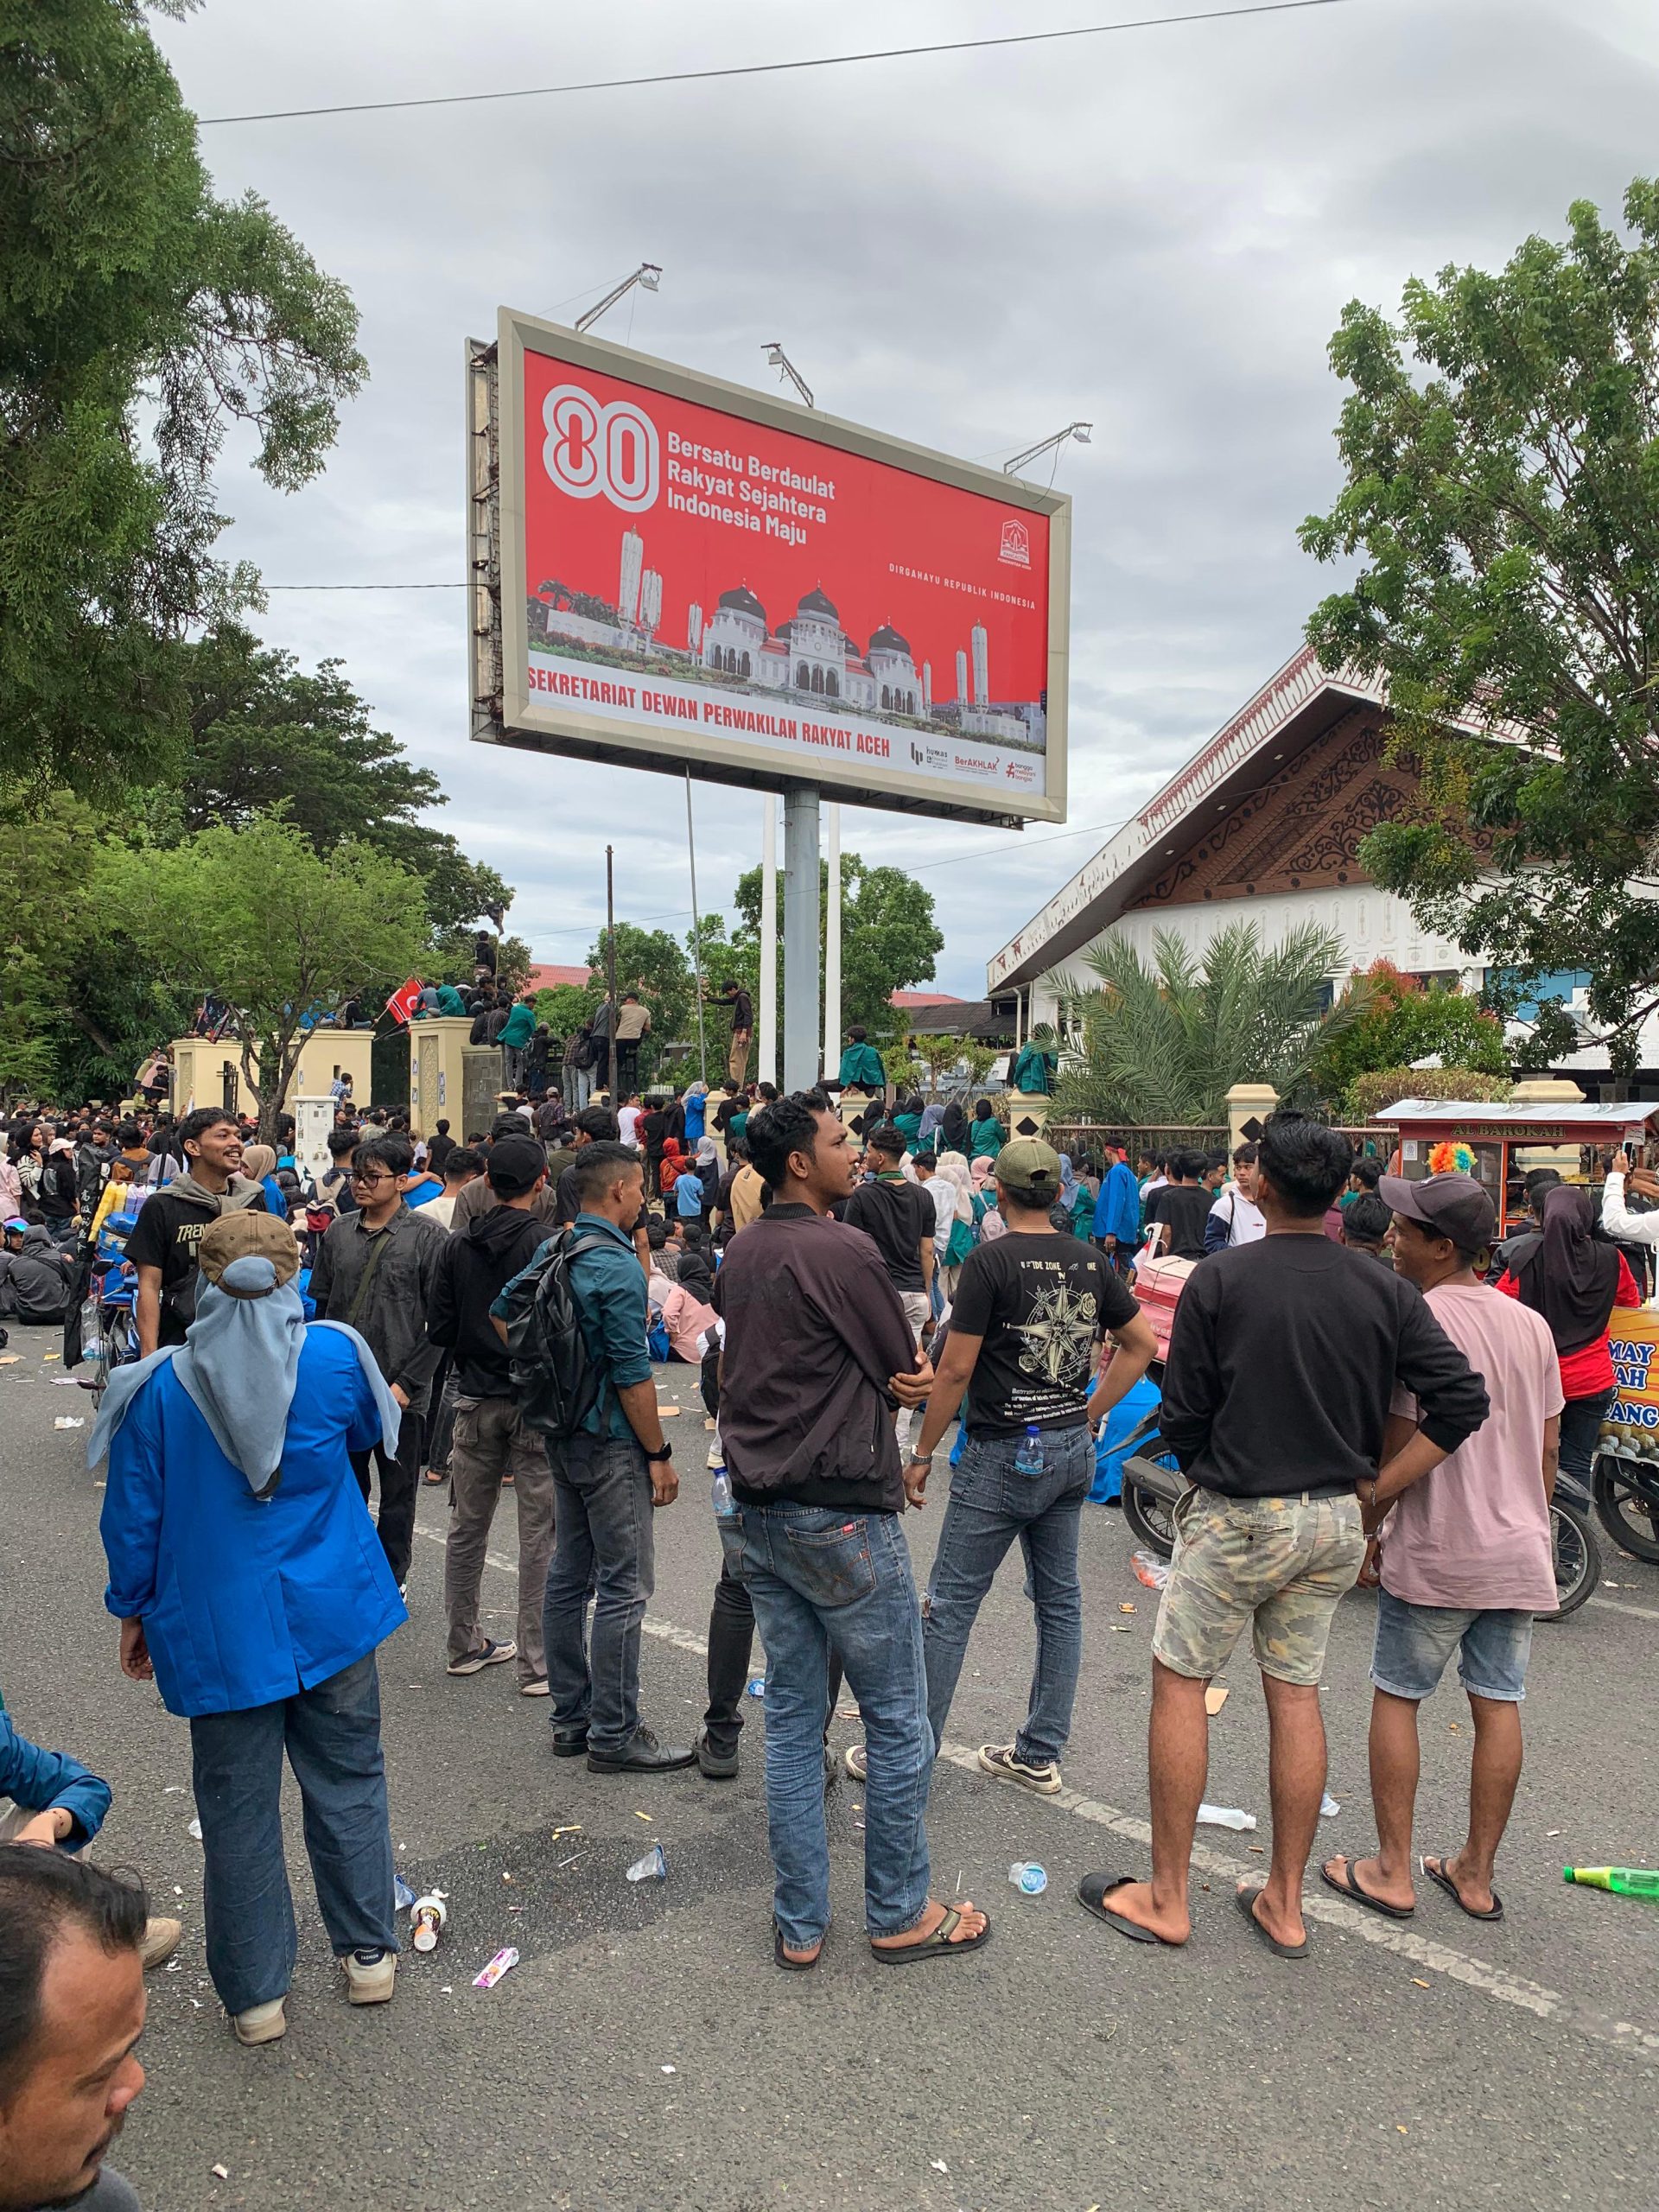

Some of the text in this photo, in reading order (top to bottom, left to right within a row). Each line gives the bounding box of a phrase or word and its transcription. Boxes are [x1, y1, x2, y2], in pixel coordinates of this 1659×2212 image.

[543, 385, 659, 512] 80
[668, 431, 835, 499] Bersatu Berdaulat
[668, 459, 826, 524] Rakyat Sejahtera
[668, 487, 806, 546] Indonesia Maju
[889, 563, 1035, 610] DIRGAHAYU REPUBLIK INDONESIA
[528, 666, 890, 758] SEKRETARIAT DEWAN PERWAKILAN RAKYAT ACEH
[955, 755, 998, 771] BerAKHLAK
[1452, 1124, 1565, 1137] AL BAROKAH
